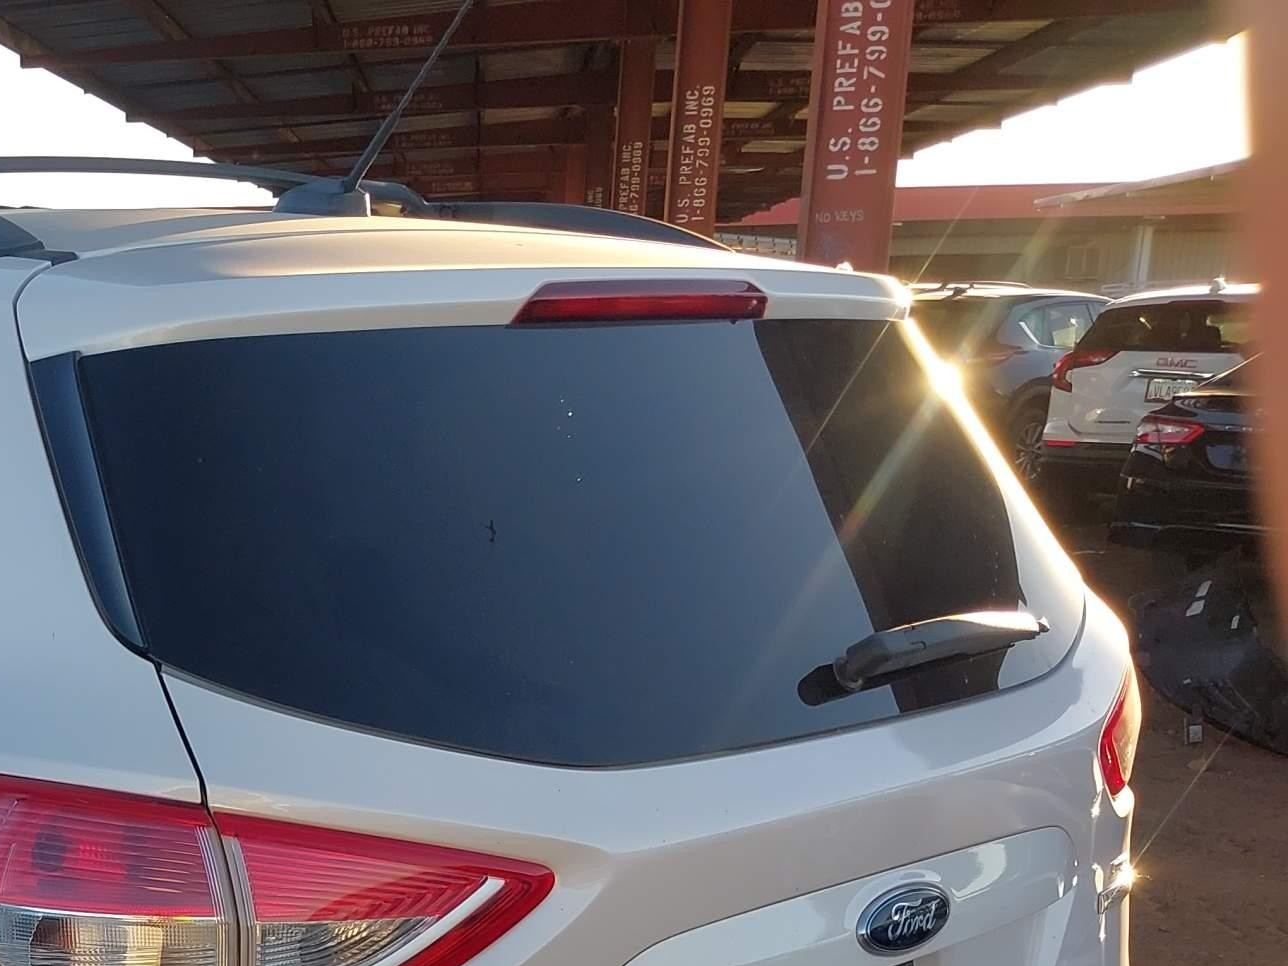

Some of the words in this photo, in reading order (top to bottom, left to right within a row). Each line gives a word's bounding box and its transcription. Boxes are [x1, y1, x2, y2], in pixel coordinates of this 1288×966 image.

[832, 1, 863, 110] PREFAB
[679, 123, 697, 185] PREFAB
[691, 85, 715, 221] 1-866-799-0969
[825, 127, 853, 180] U.S.
[675, 193, 691, 223] U.S.
[815, 212, 831, 223] NO
[834, 209, 865, 223] KEYS
[1156, 357, 1198, 368] GMC
[887, 898, 942, 942] Ford
